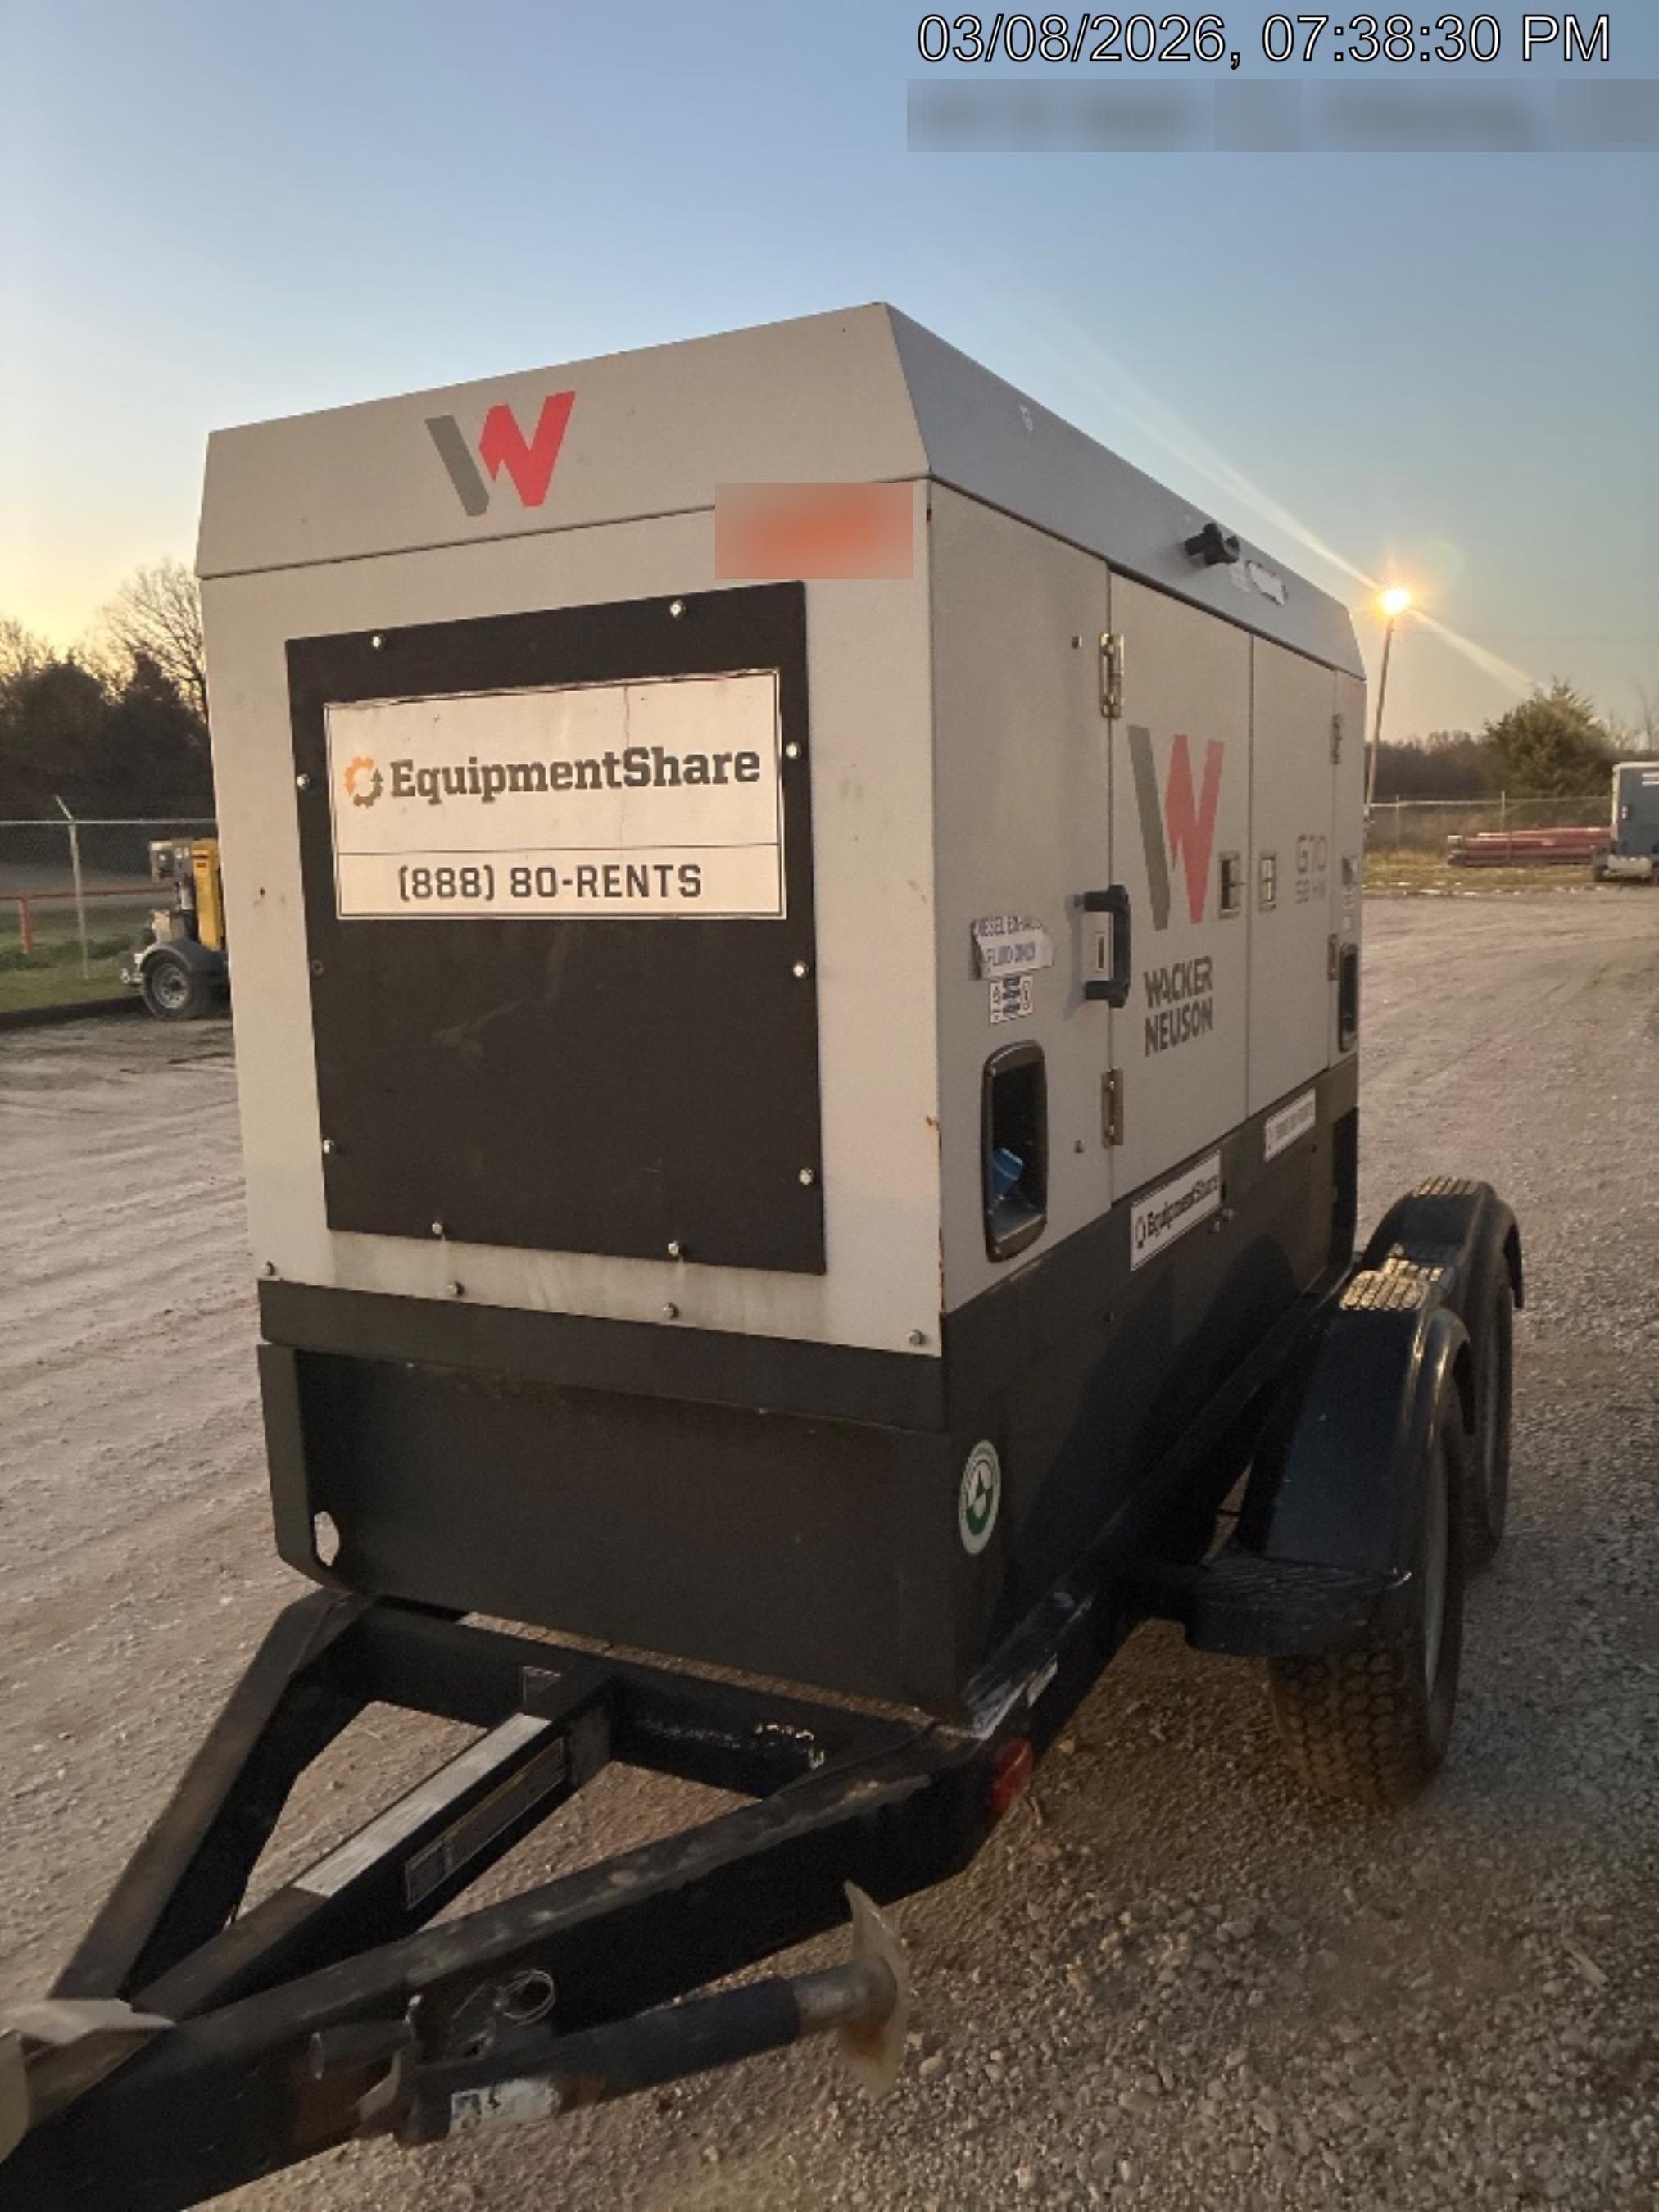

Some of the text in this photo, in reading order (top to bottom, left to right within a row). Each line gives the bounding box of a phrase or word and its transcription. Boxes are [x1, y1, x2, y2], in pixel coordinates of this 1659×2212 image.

[389, 746, 760, 806] EquipmentShare
[399, 863, 703, 902] (888) 80-RENTS
[1143, 955, 1213, 1009] WACKER
[1144, 996, 1213, 1058] NEUSON
